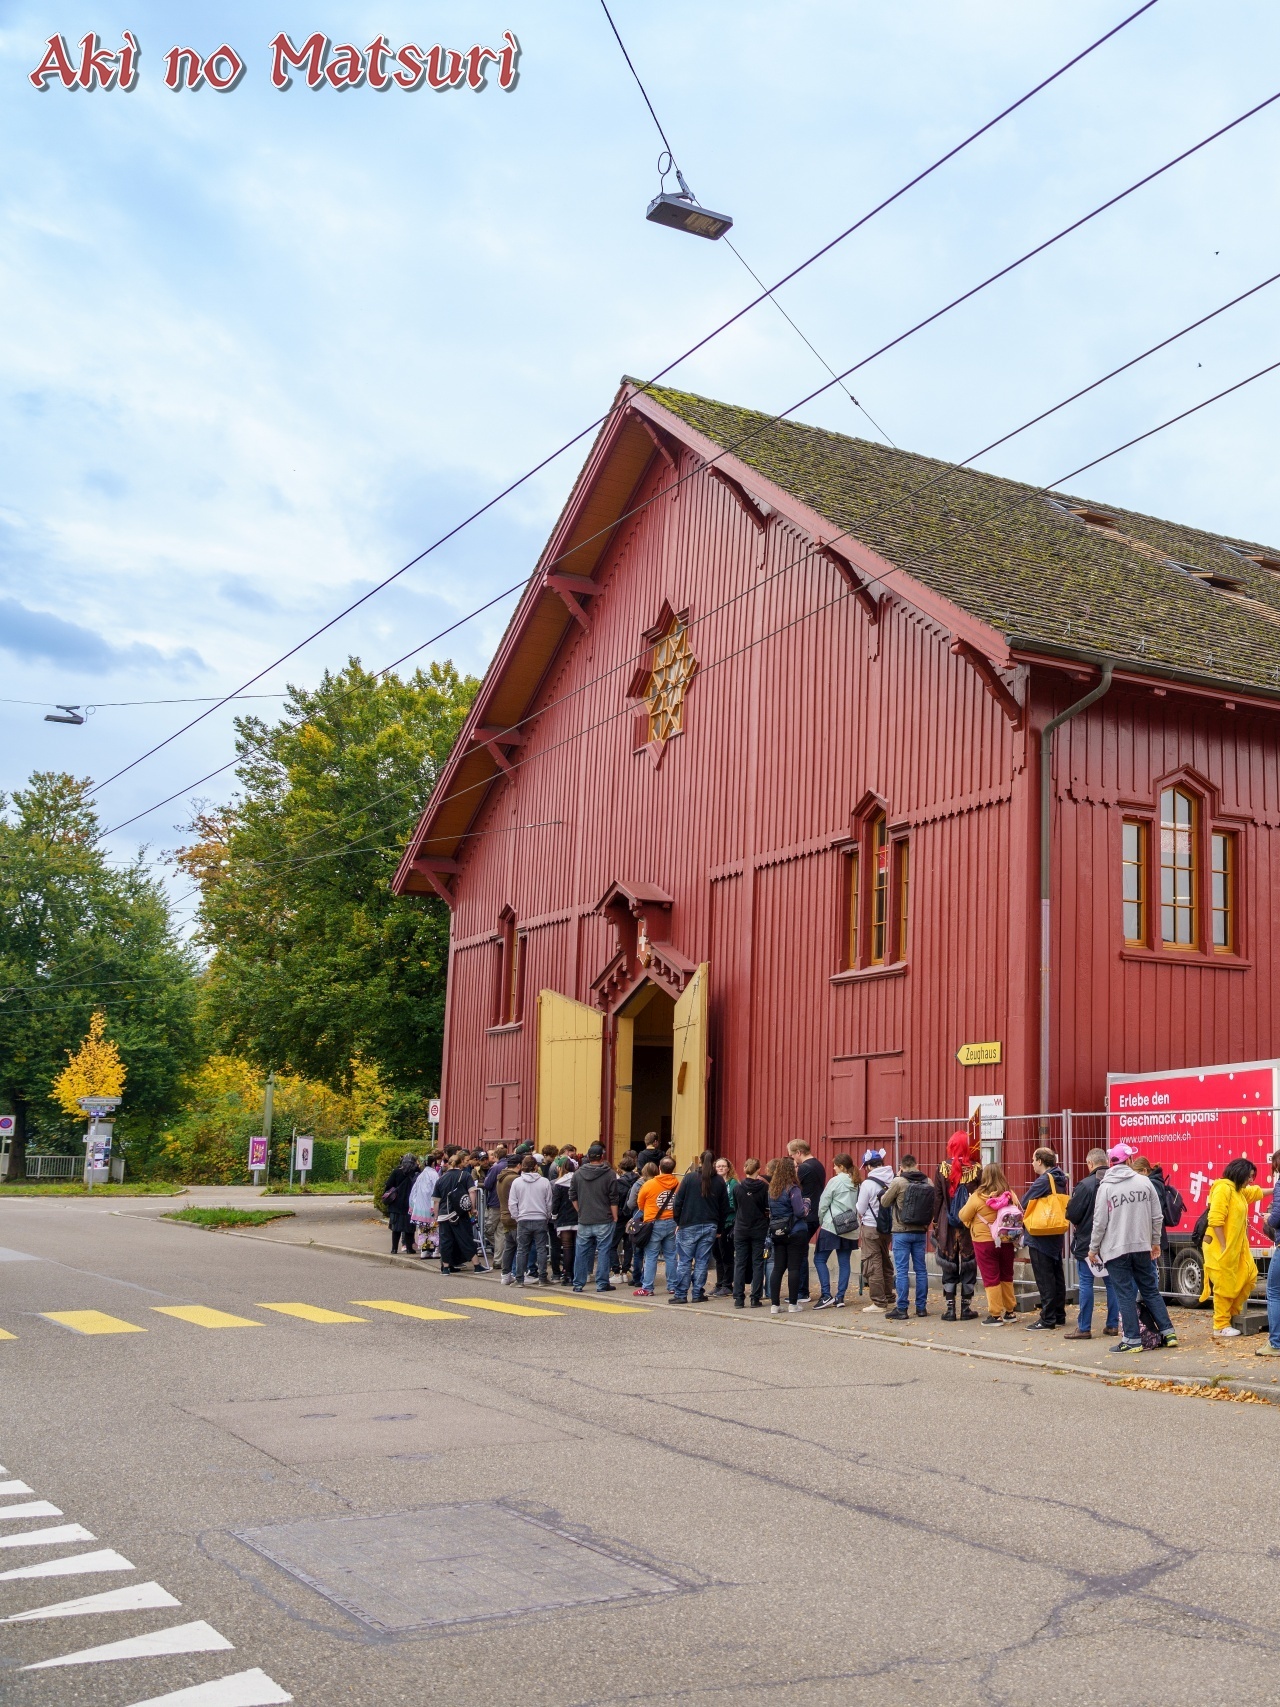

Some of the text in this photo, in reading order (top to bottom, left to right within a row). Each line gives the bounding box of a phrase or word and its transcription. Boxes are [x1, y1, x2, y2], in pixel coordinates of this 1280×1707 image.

[965, 1046, 997, 1064] Zeughaus
[1119, 1091, 1170, 1108] Erlebe den
[1119, 1108, 1219, 1128] Geschmack Japans!
[1119, 1131, 1192, 1144] www.umamisnack.ch
